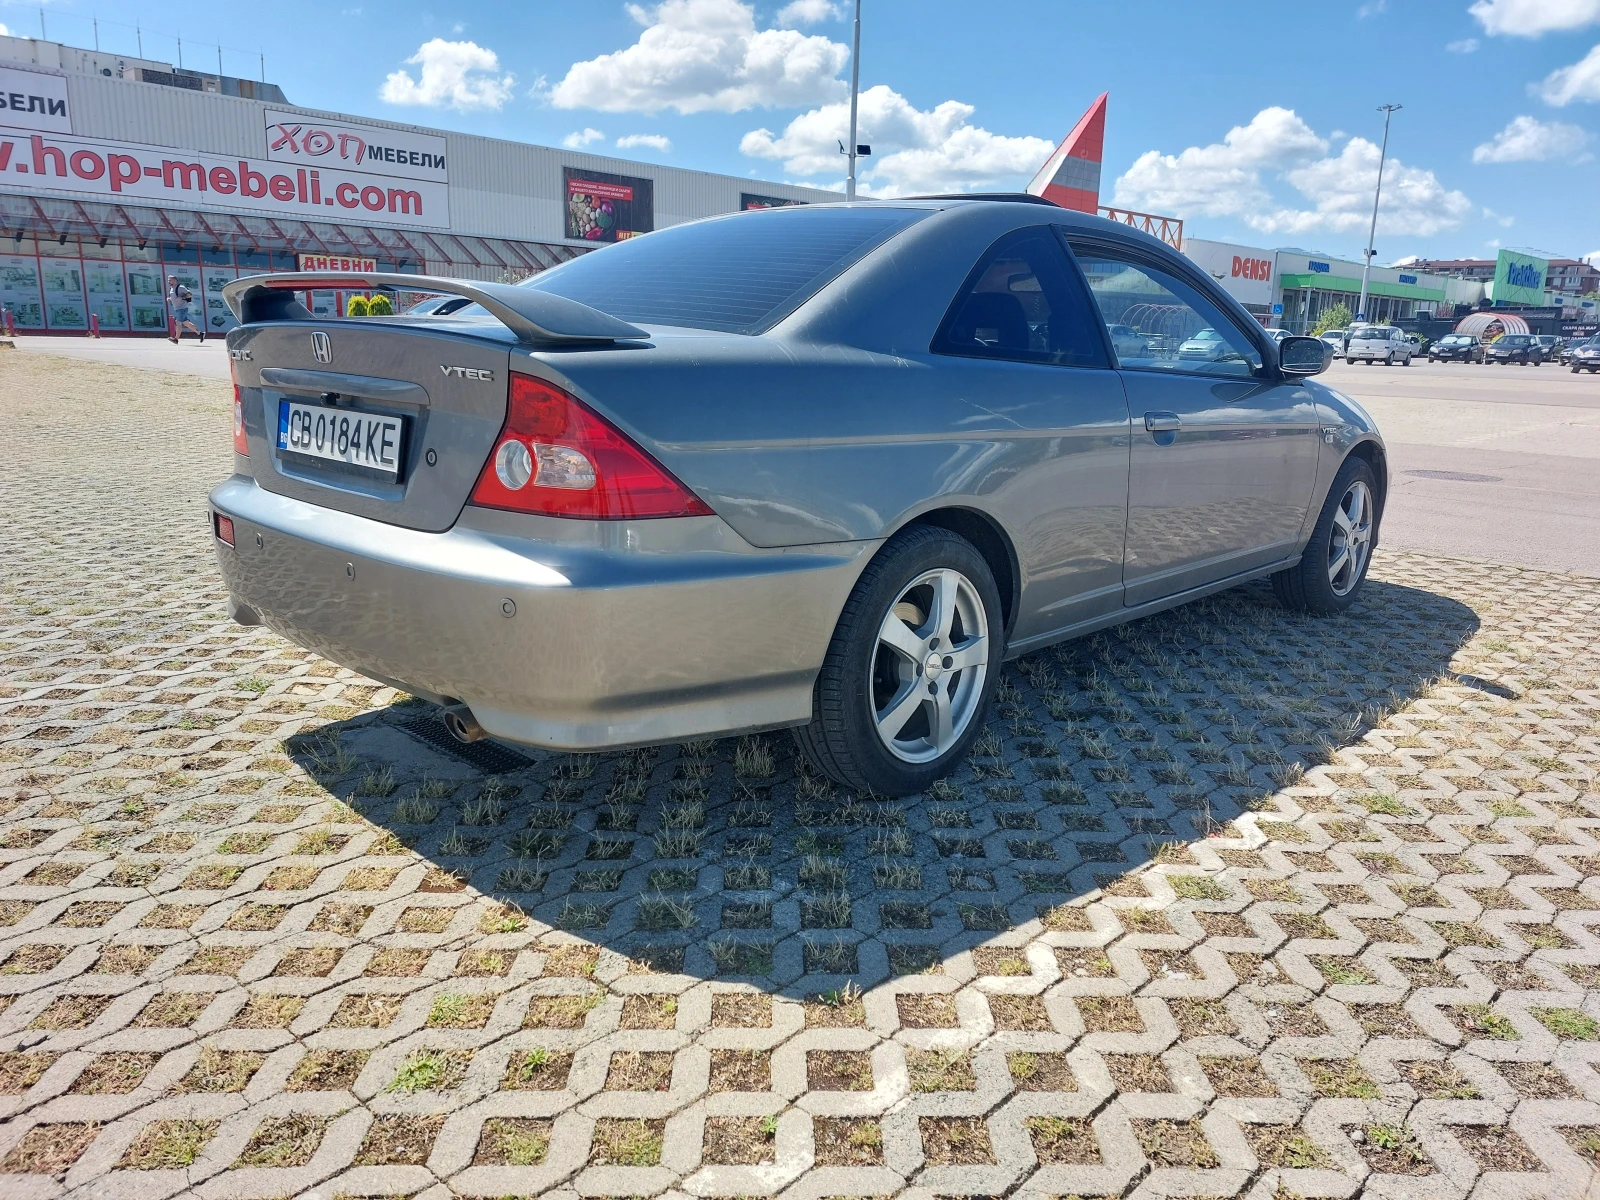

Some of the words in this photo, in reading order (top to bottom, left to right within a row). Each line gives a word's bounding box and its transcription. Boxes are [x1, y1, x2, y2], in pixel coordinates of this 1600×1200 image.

[271, 123, 366, 165] ХОП
[368, 145, 446, 169] МЕБЕЛИ
[304, 257, 374, 272] ДНЕВНИ
[1231, 255, 1272, 281] DENSI
[440, 365, 492, 381] VTEC
